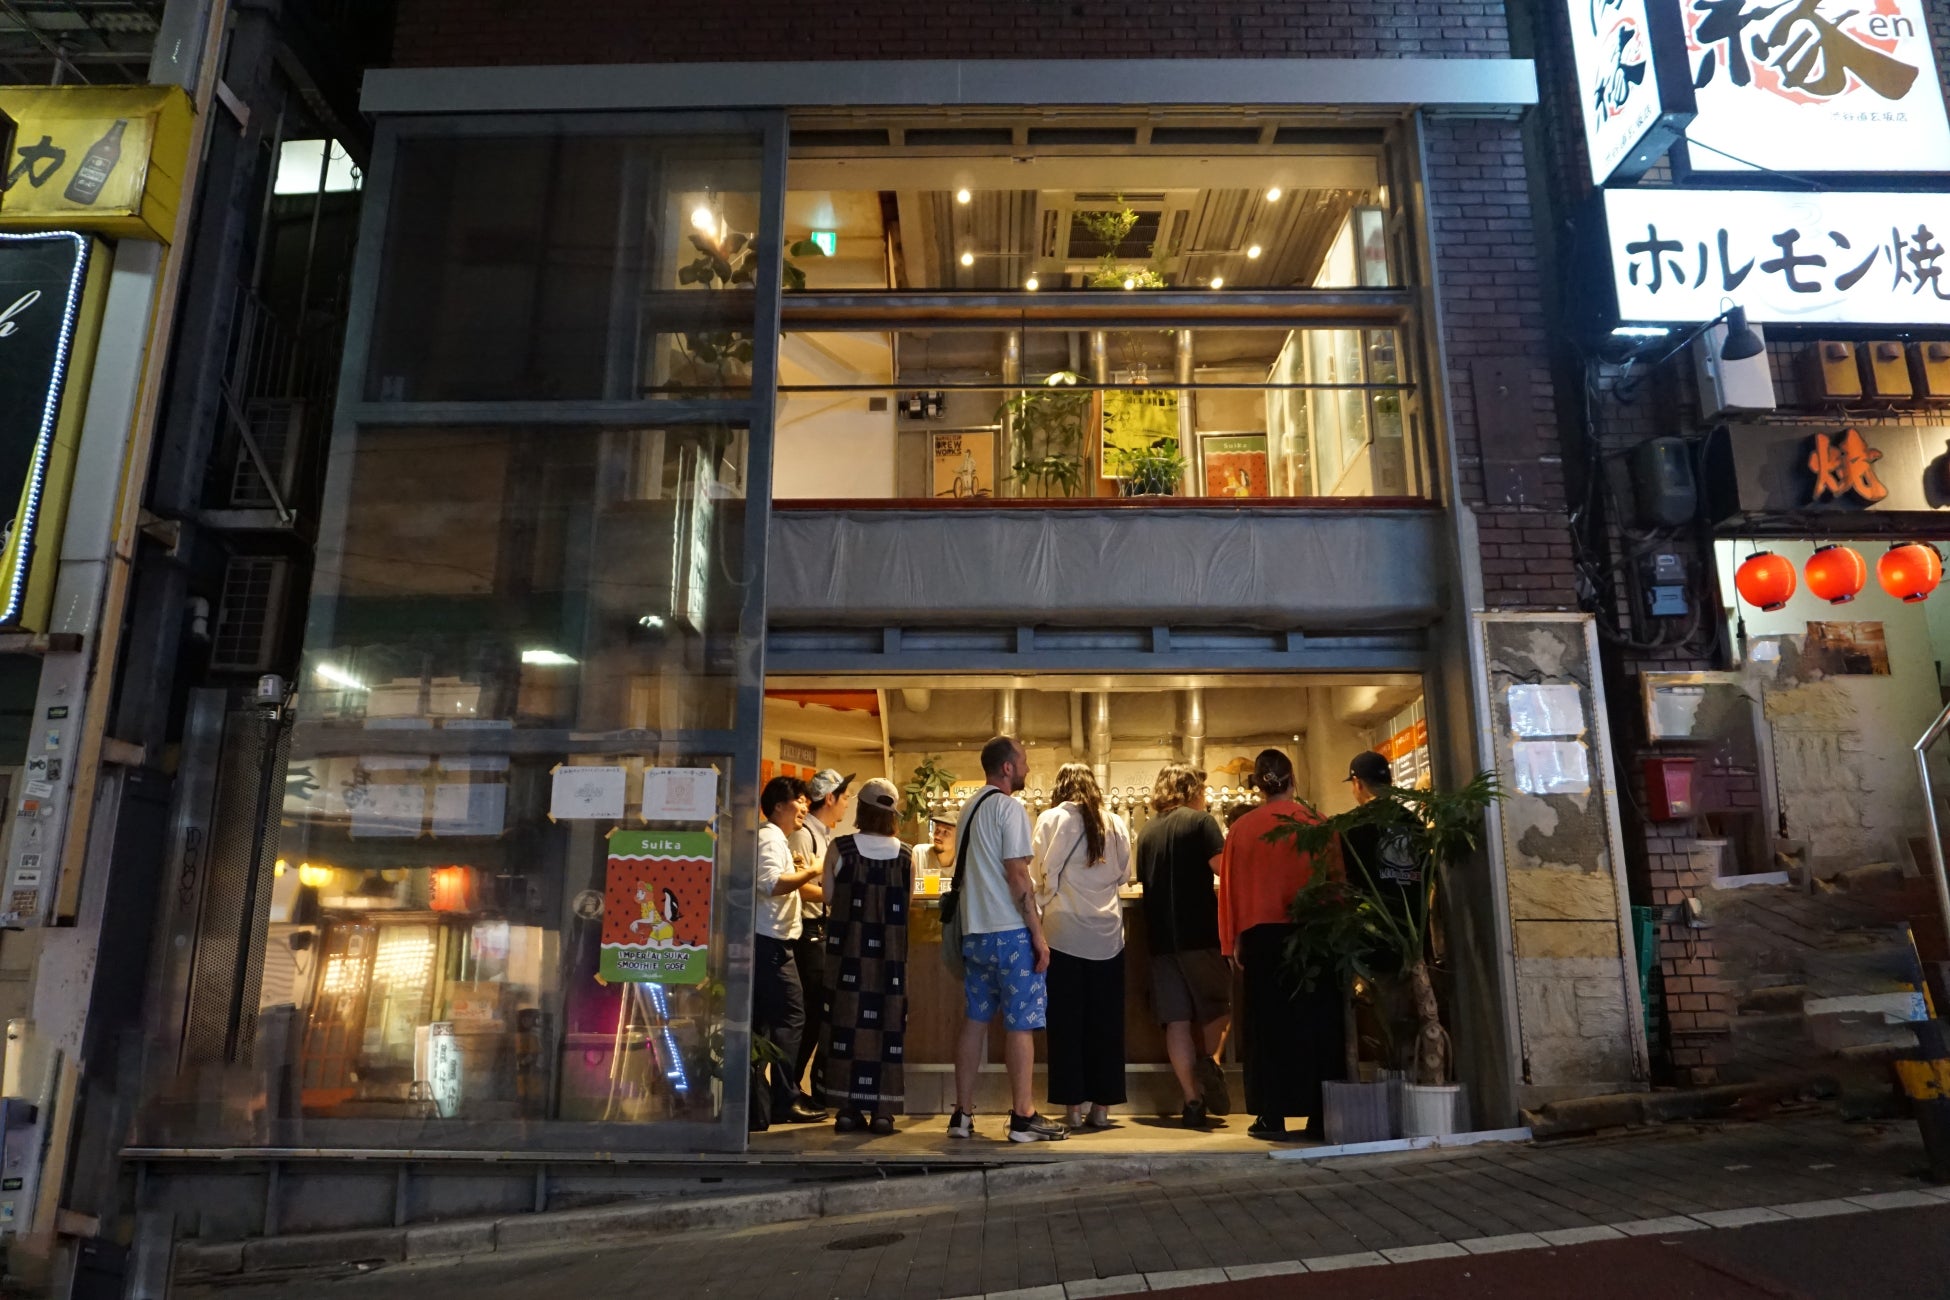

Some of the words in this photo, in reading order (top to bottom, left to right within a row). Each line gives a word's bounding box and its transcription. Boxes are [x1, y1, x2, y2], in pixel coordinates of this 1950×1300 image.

[1869, 15, 1914, 37] en
[1626, 223, 1950, 301] ホルモン焼
[641, 839, 681, 850] Suika
[618, 951, 661, 961] IMPERIAL
[664, 951, 690, 961] SUIKA
[617, 961, 659, 970] SMOOTHIE
[664, 962, 686, 971] GOSE
